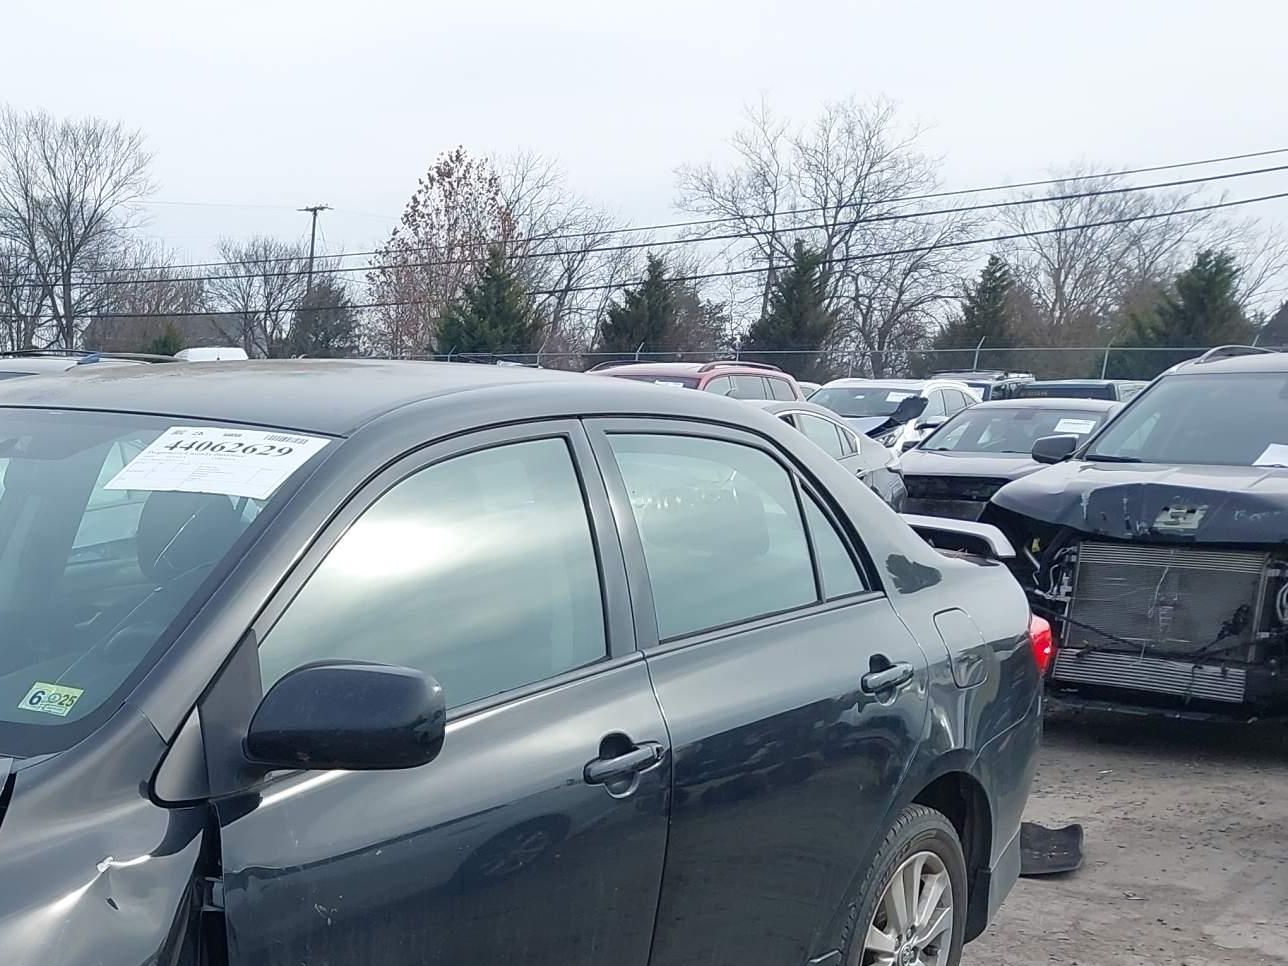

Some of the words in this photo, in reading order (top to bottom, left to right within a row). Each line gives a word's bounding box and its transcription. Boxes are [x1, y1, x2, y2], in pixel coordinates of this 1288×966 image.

[164, 439, 294, 457] 44062629
[28, 690, 46, 706] 6
[57, 694, 78, 707] 25
